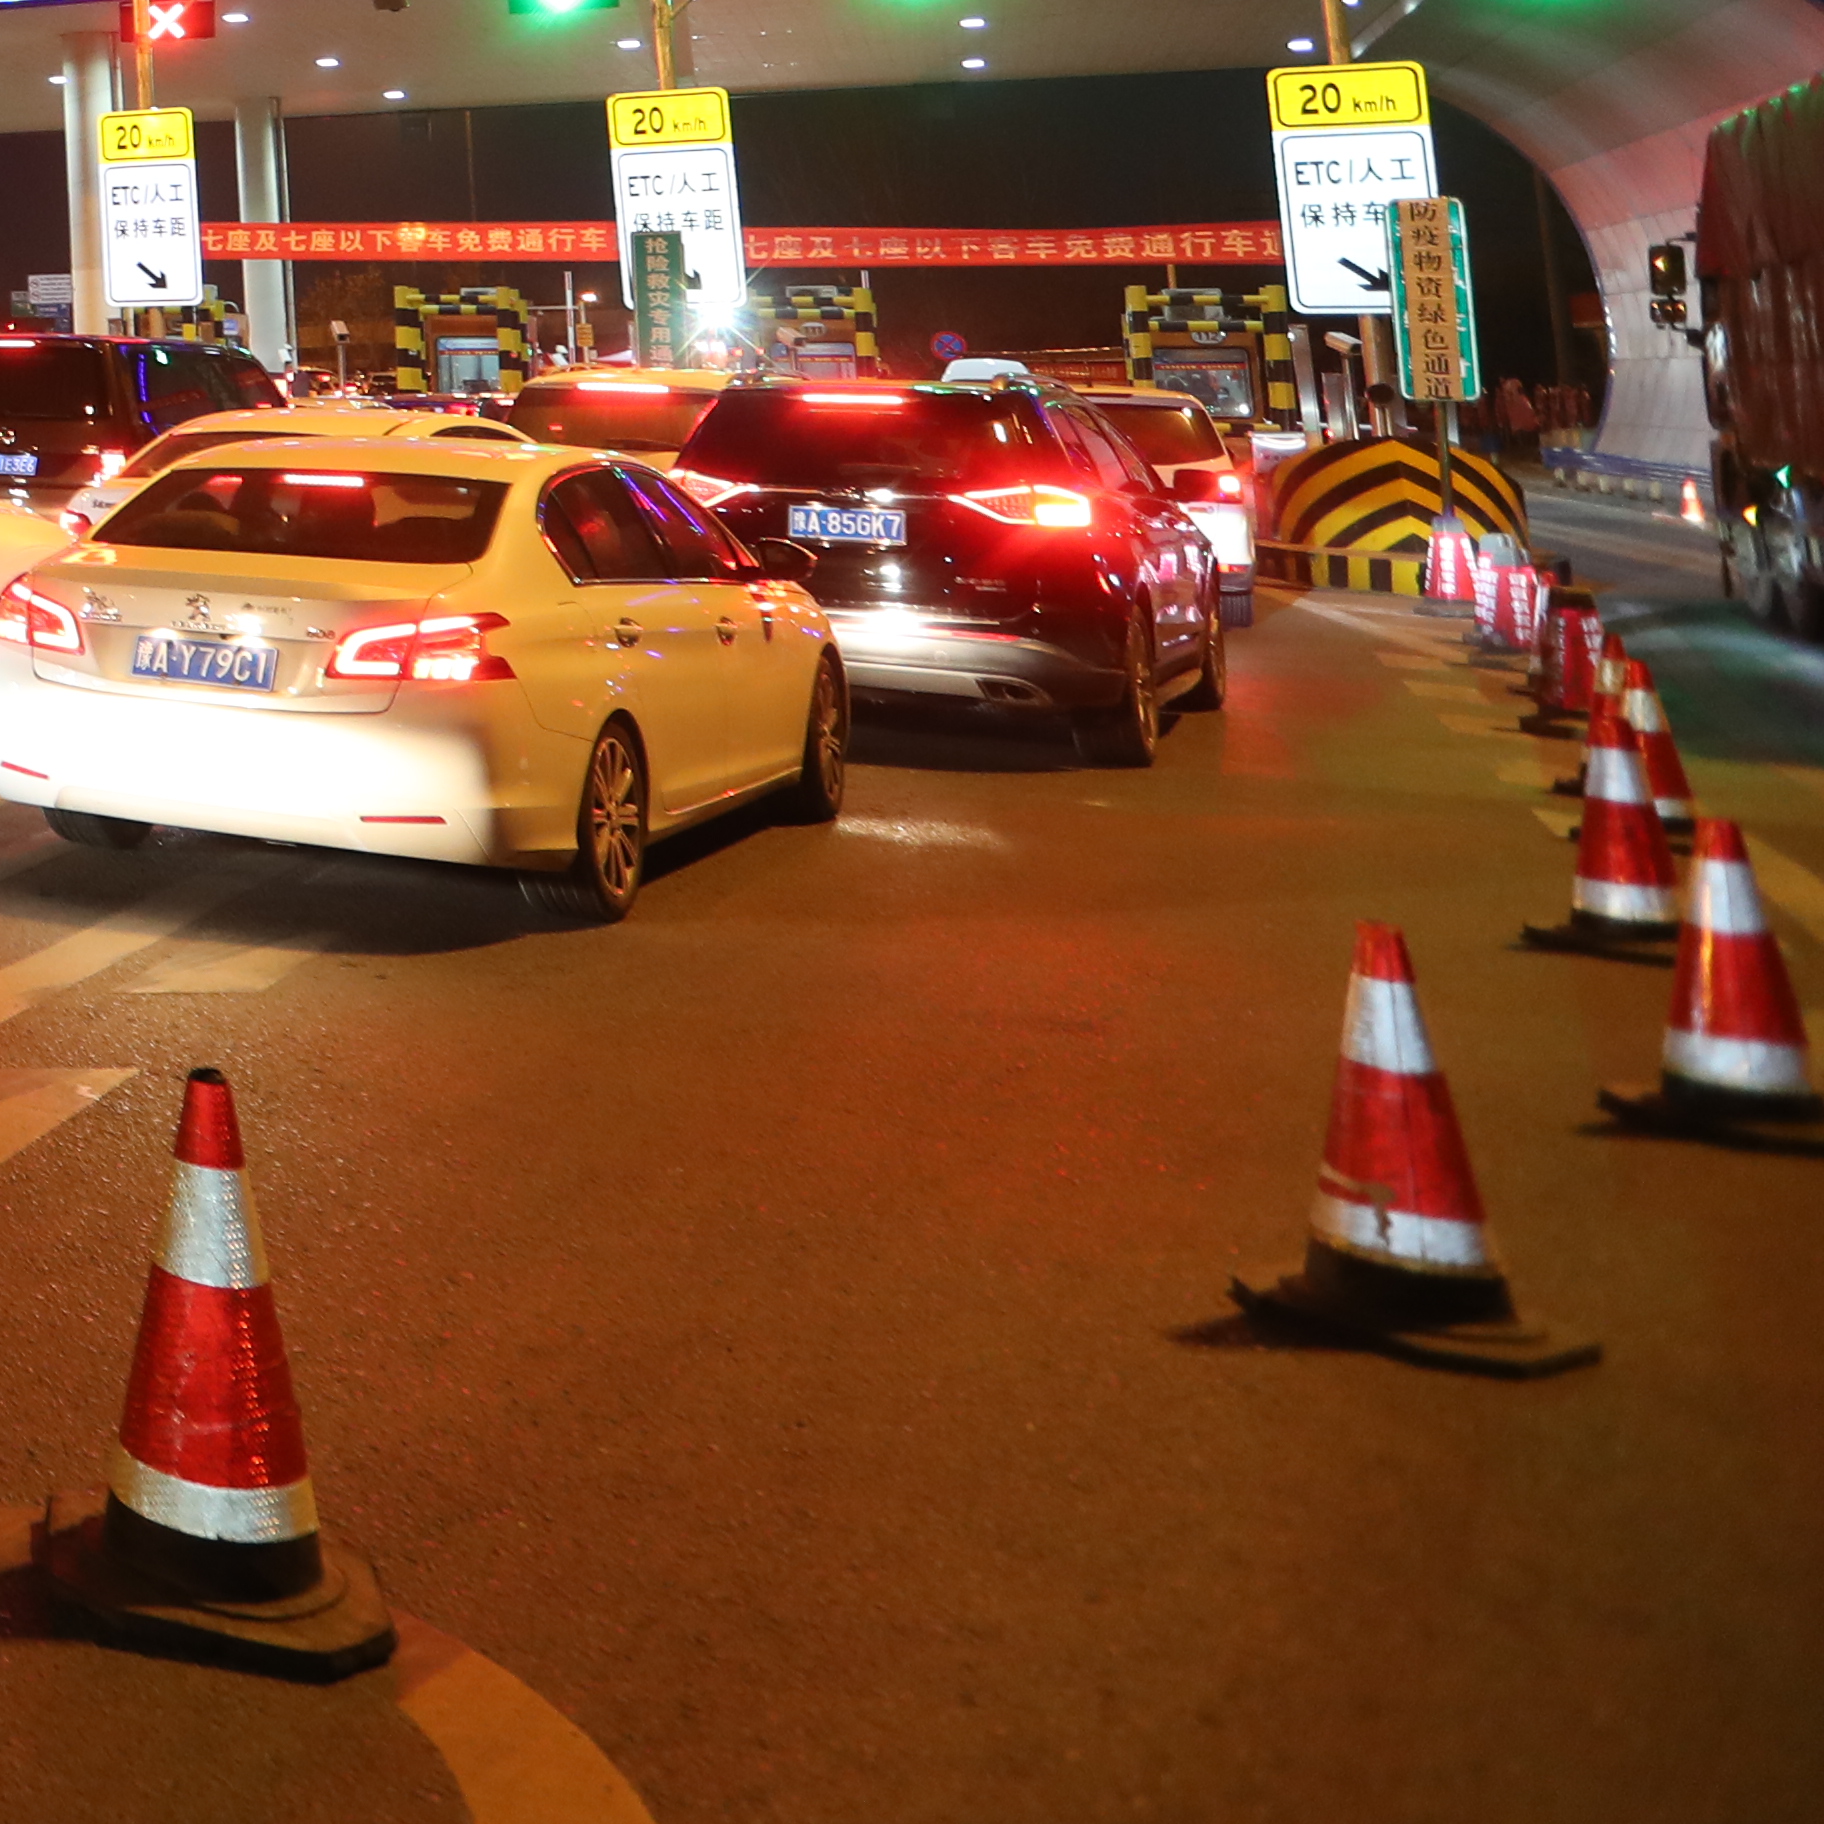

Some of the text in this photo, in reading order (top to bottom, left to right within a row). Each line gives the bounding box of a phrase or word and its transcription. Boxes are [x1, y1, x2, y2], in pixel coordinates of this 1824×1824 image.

[1299, 82, 1397, 116] 20 km/h
[632, 106, 707, 135] 20 km/h
[116, 124, 175, 150] 20 km/h
[627, 171, 720, 197] ETC/人工
[1294, 157, 1416, 186] ETC/人工
[111, 183, 184, 206] ETC/人工
[114, 216, 187, 239] 保持车距
[632, 208, 724, 232] 保持车距
[645, 236, 675, 368] 抢险救灾专用通
[1408, 201, 1453, 400] 防疫物资绿色通道
